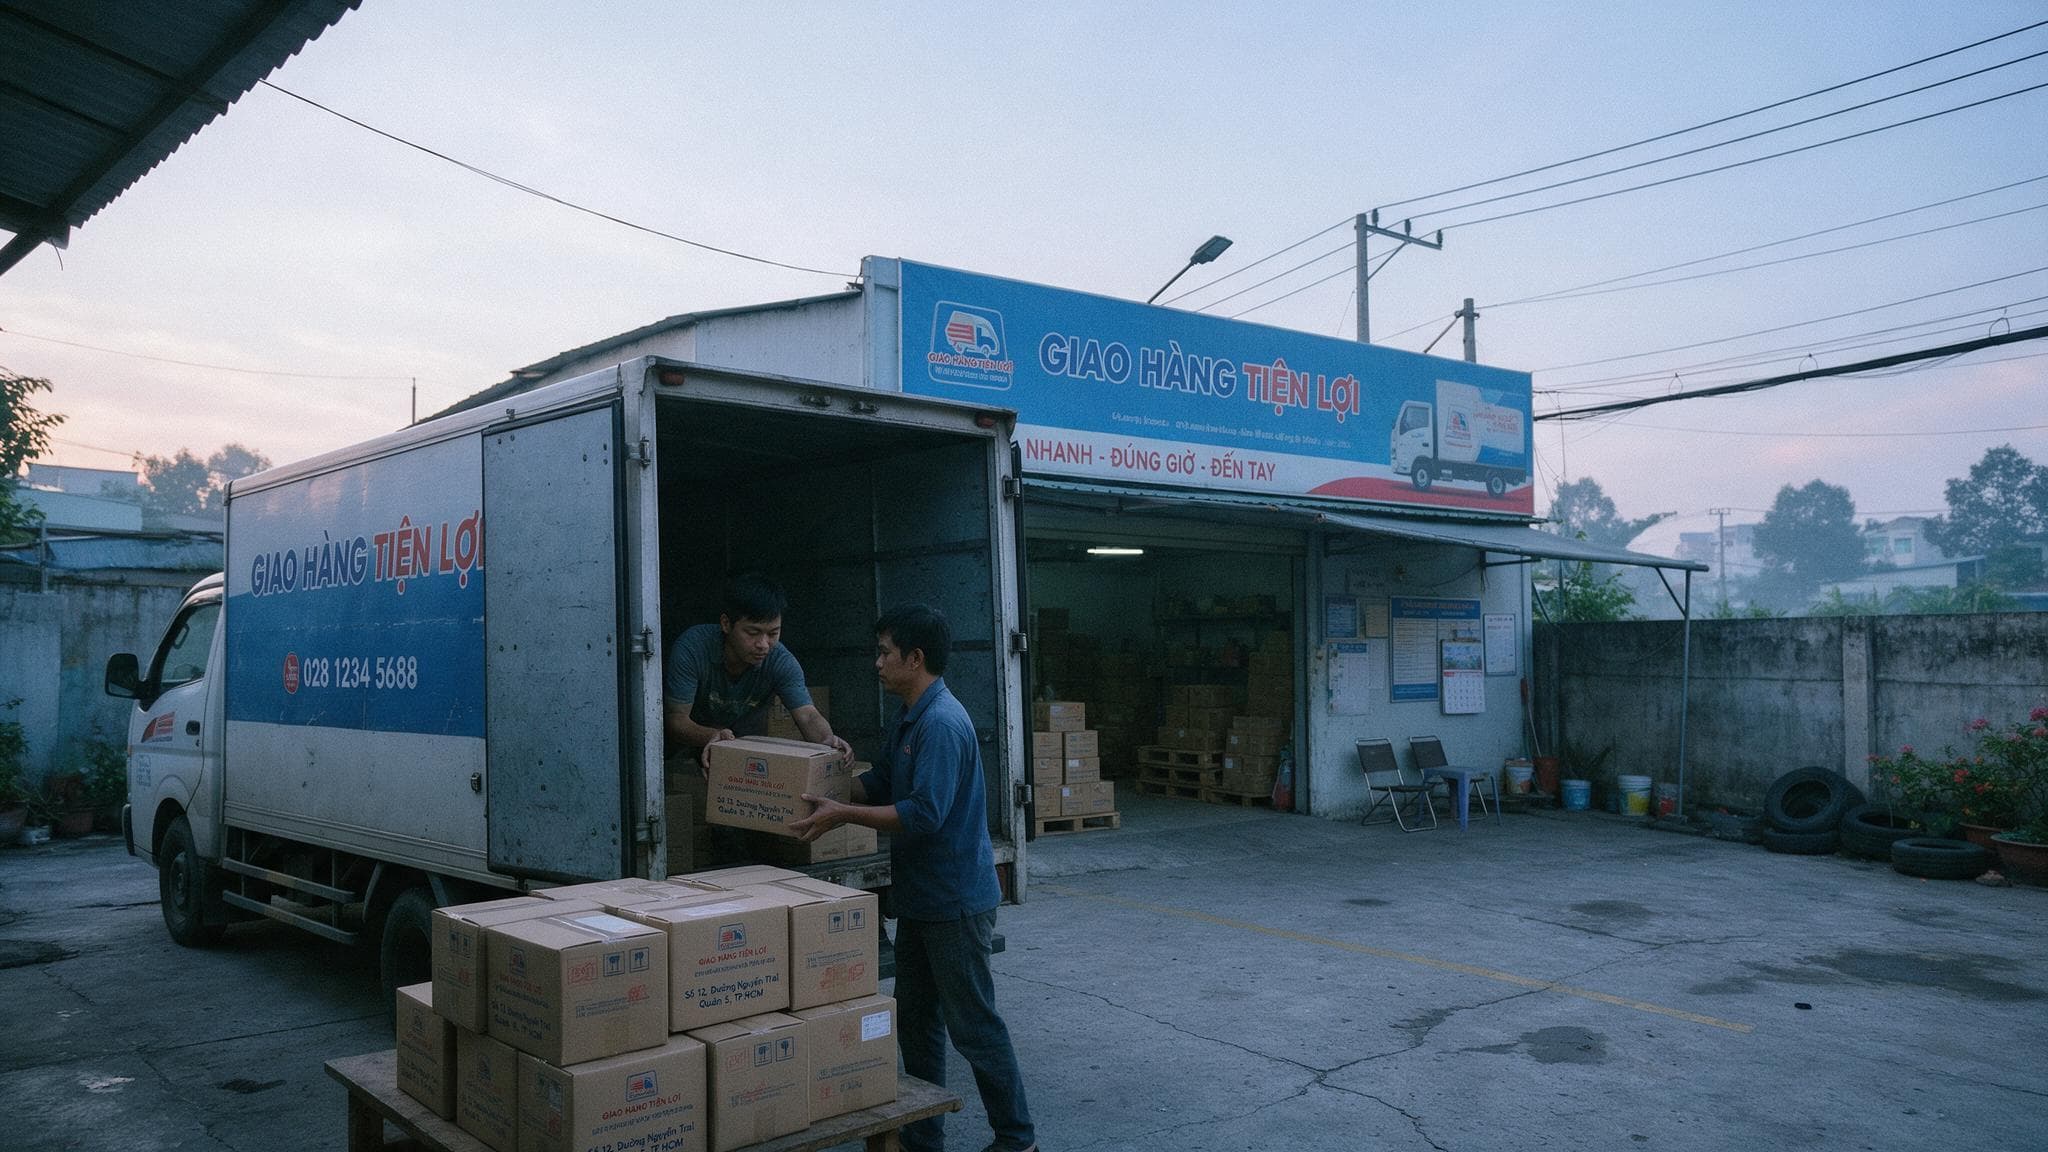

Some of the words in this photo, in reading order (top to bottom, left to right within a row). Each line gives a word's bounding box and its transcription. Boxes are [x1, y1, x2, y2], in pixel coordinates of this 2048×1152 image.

[1039, 332, 1131, 384] GIAO
[1138, 340, 1237, 398] HÀNG
[1242, 357, 1308, 416] TIỆN
[1316, 373, 1360, 424] LỢI
[1026, 438, 1093, 465] NHANH
[1110, 443, 1161, 472] ĐÚNG
[1166, 449, 1197, 475] GIỜ
[1210, 450, 1243, 479] ĐẾN
[1248, 460, 1276, 482] TAY
[251, 548, 298, 599] GIAO
[301, 529, 369, 592] HÀNG
[373, 514, 432, 596] TIỆN
[438, 509, 484, 590] LỢI
[303, 656, 329, 688] 028
[334, 656, 371, 689] 1234
[375, 655, 418, 690] 5688
